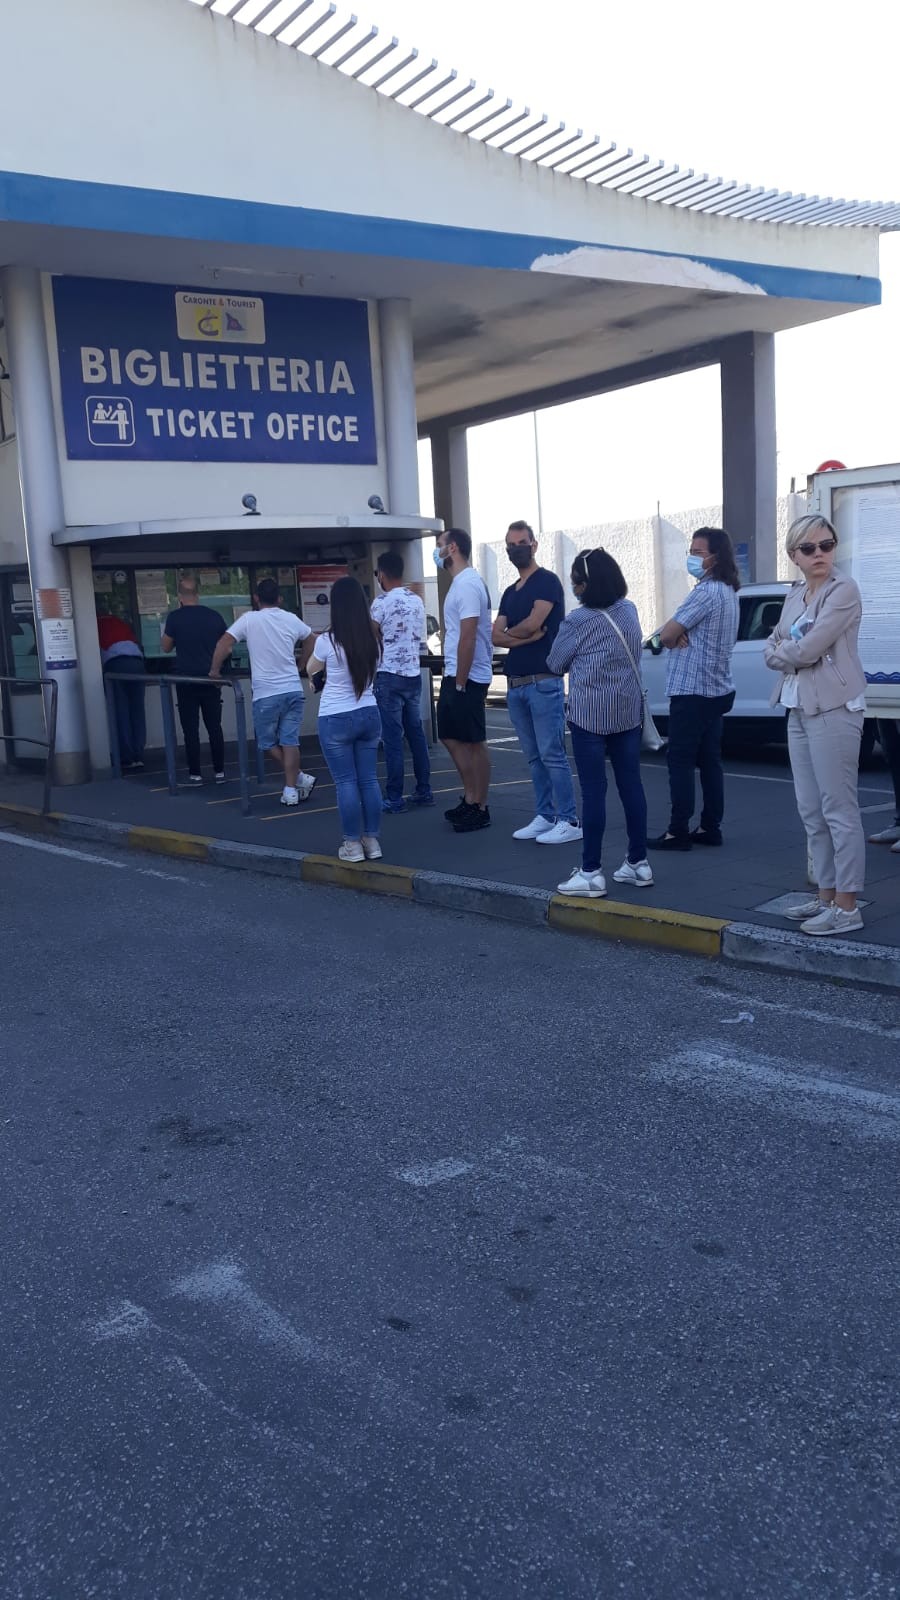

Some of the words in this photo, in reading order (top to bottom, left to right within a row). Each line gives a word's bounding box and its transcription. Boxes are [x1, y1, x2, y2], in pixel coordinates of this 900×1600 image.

[182, 295, 217, 306] CARONTE
[227, 298, 256, 308] TOURIST
[80, 346, 355, 394] BIGLIETTERIA
[146, 408, 254, 439] TICKET
[266, 413, 359, 442] OFFICE
